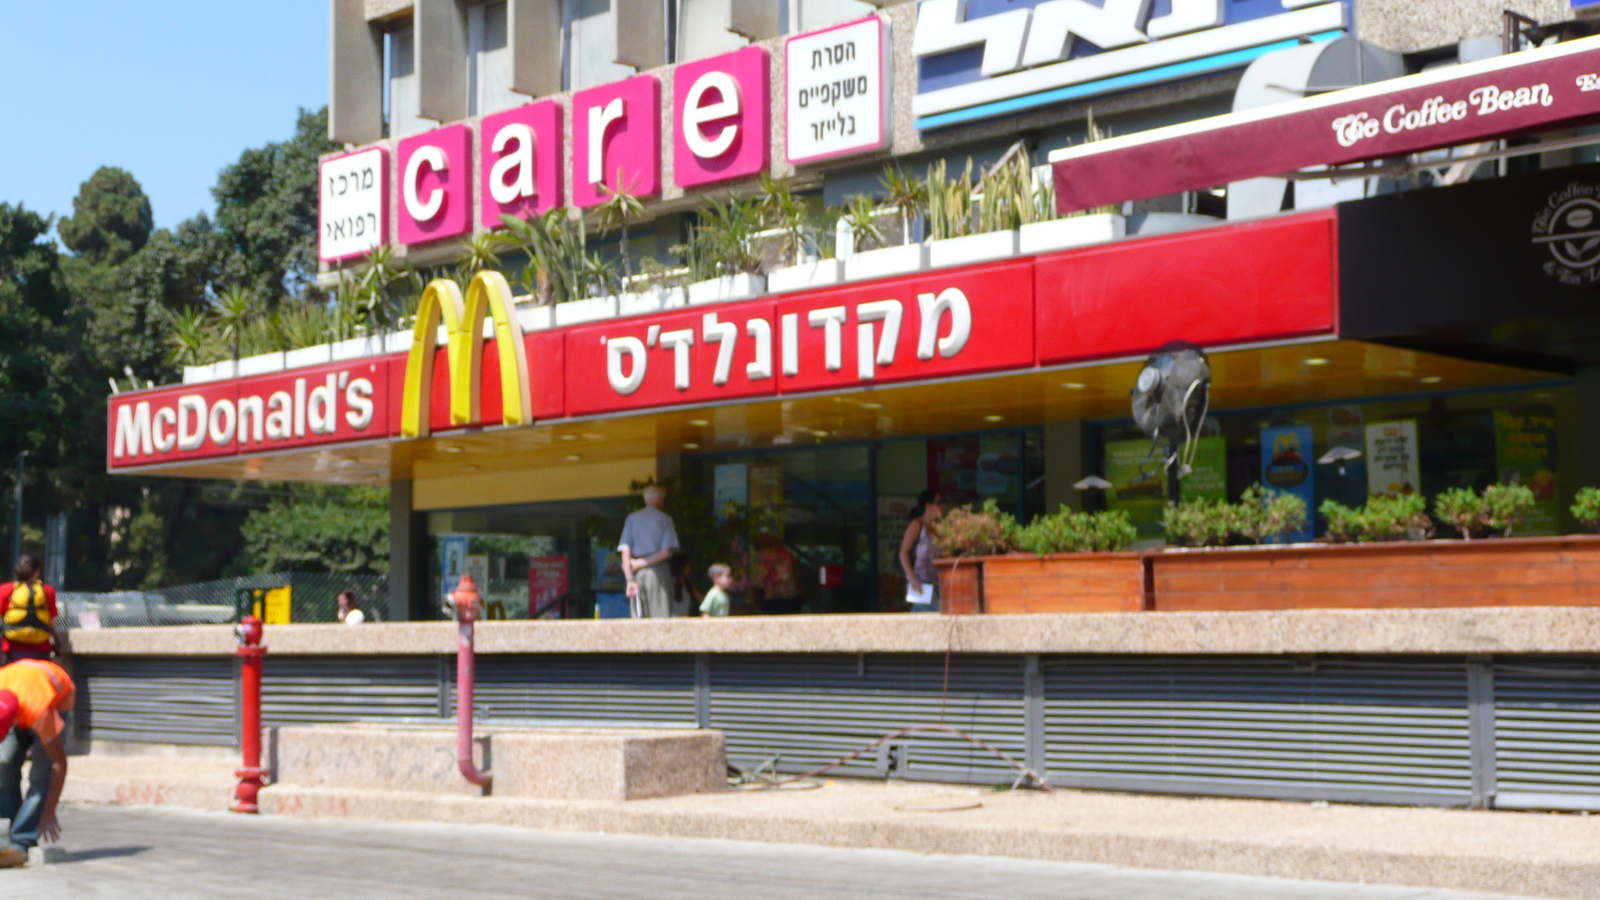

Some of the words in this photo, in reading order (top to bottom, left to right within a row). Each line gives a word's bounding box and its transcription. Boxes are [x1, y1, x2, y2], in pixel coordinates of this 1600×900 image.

[811, 41, 855, 70] הסרת
[799, 75, 868, 108] משקפיים
[810, 111, 856, 142] בלייזר
[1331, 111, 1380, 147] The
[1382, 95, 1468, 134] Coffee
[1468, 83, 1553, 116] Bean
[402, 70, 742, 223] care
[329, 167, 373, 197] מרכז
[326, 212, 376, 241] רפואי
[606, 287, 972, 395] מקדונלד'ס
[113, 370, 375, 459] McDonald's
